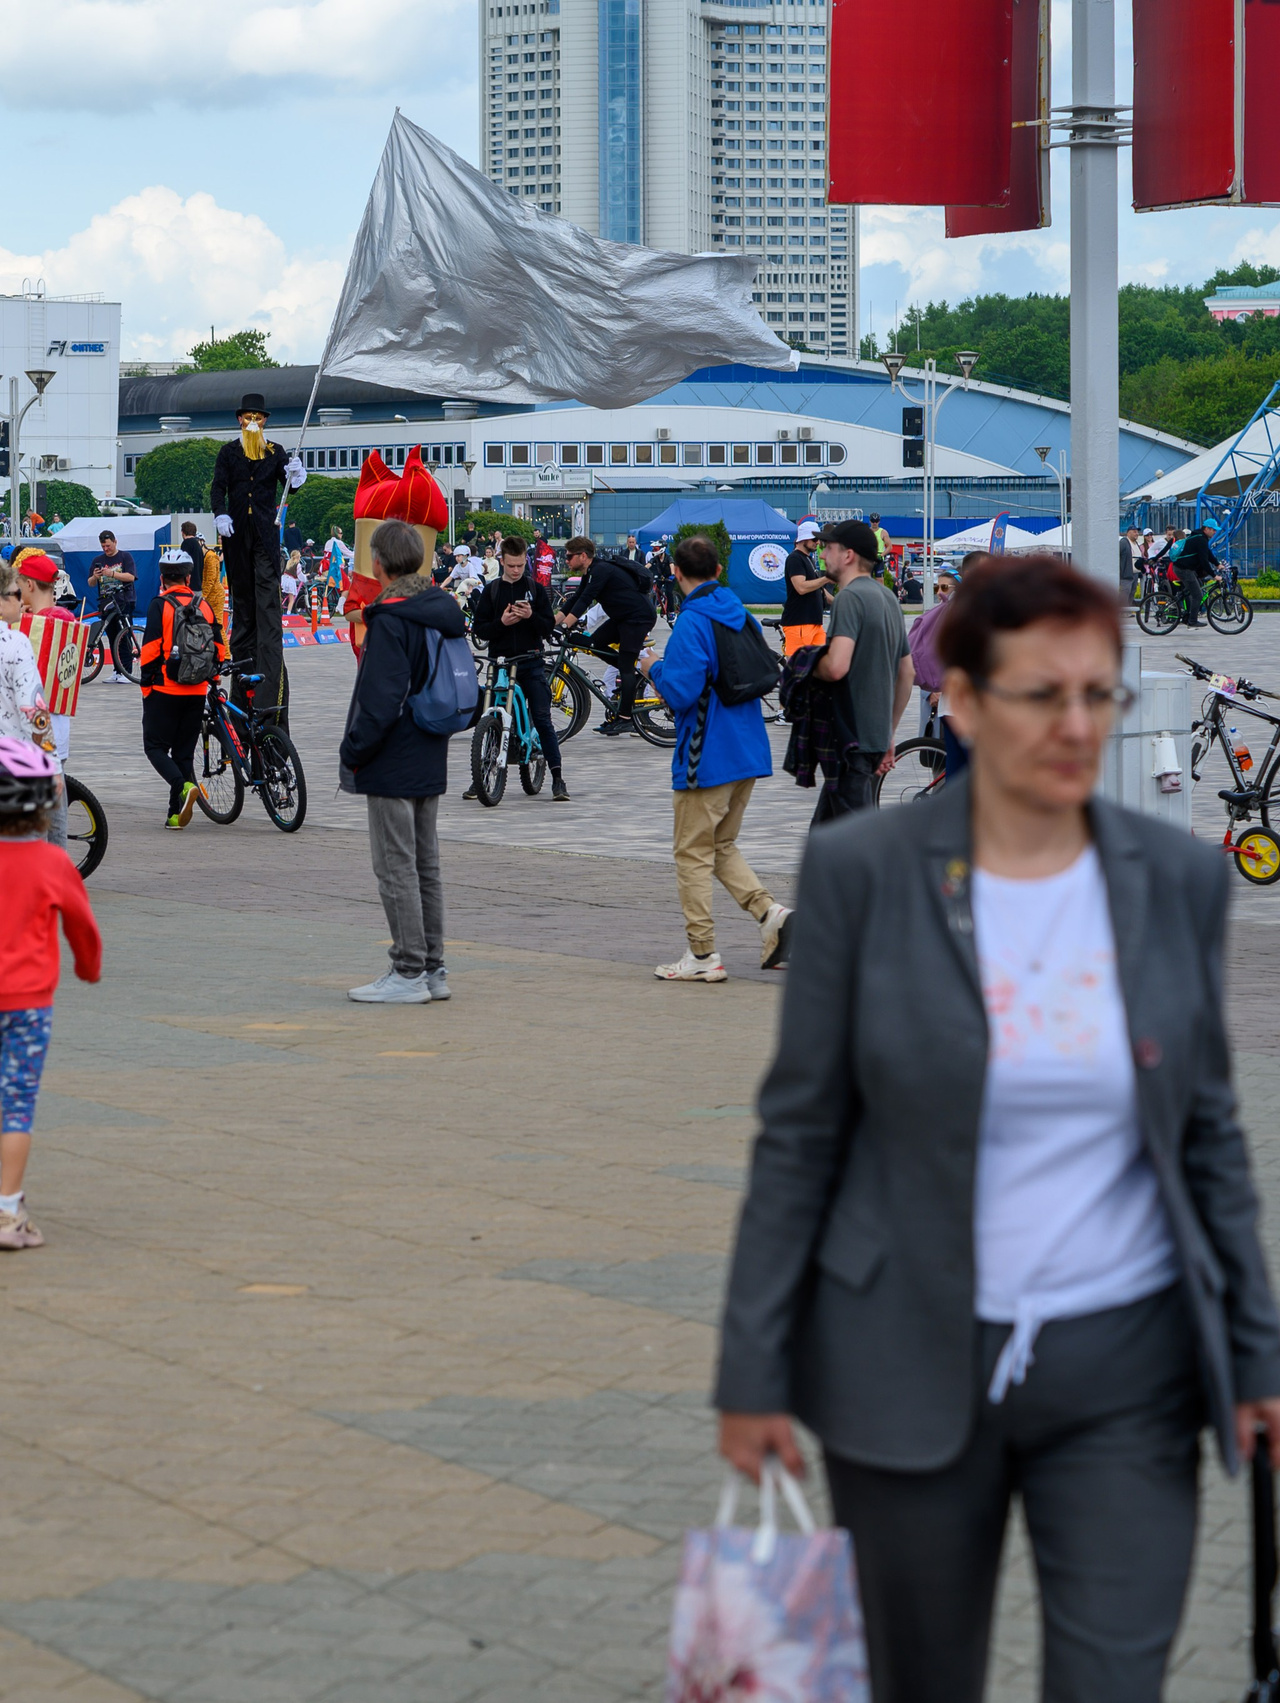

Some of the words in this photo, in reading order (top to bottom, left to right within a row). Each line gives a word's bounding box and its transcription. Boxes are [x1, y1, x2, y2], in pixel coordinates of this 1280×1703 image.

[71, 343, 104, 352] ФИТНЕС
[60, 646, 76, 667] POP
[58, 662, 78, 683] CORN
